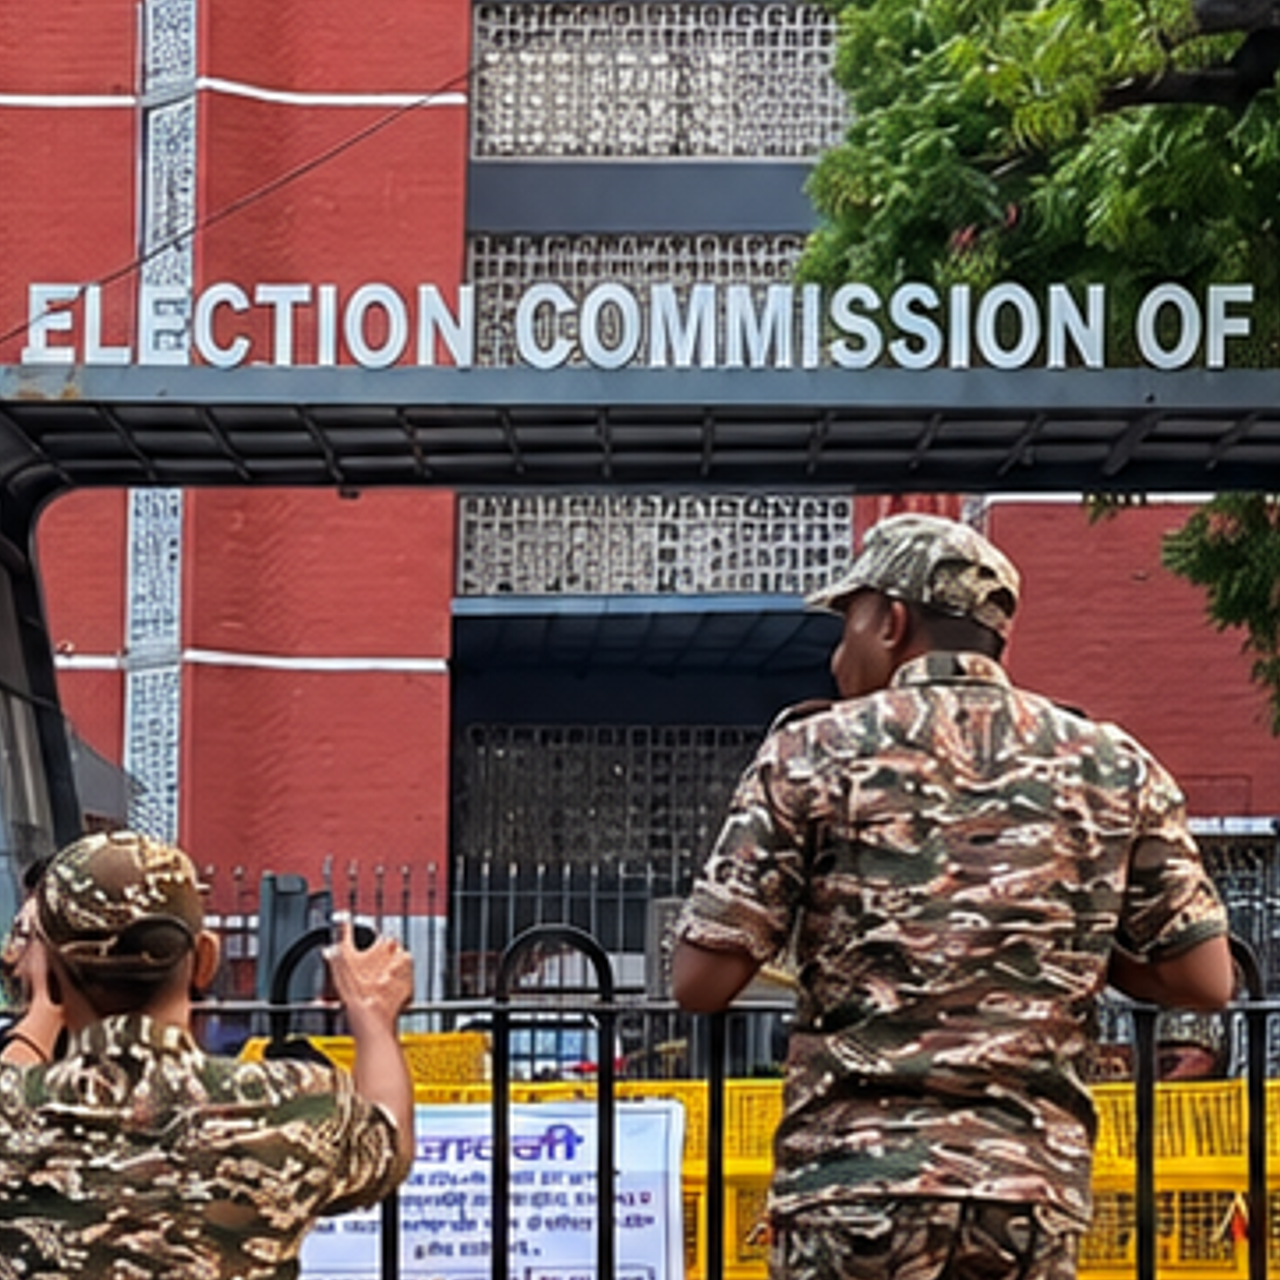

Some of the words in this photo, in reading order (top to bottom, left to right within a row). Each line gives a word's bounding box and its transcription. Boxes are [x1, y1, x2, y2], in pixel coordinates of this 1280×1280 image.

[21, 282, 475, 369] ELECTION
[519, 281, 1106, 370] COMMISSION
[1135, 282, 1255, 370] OF
